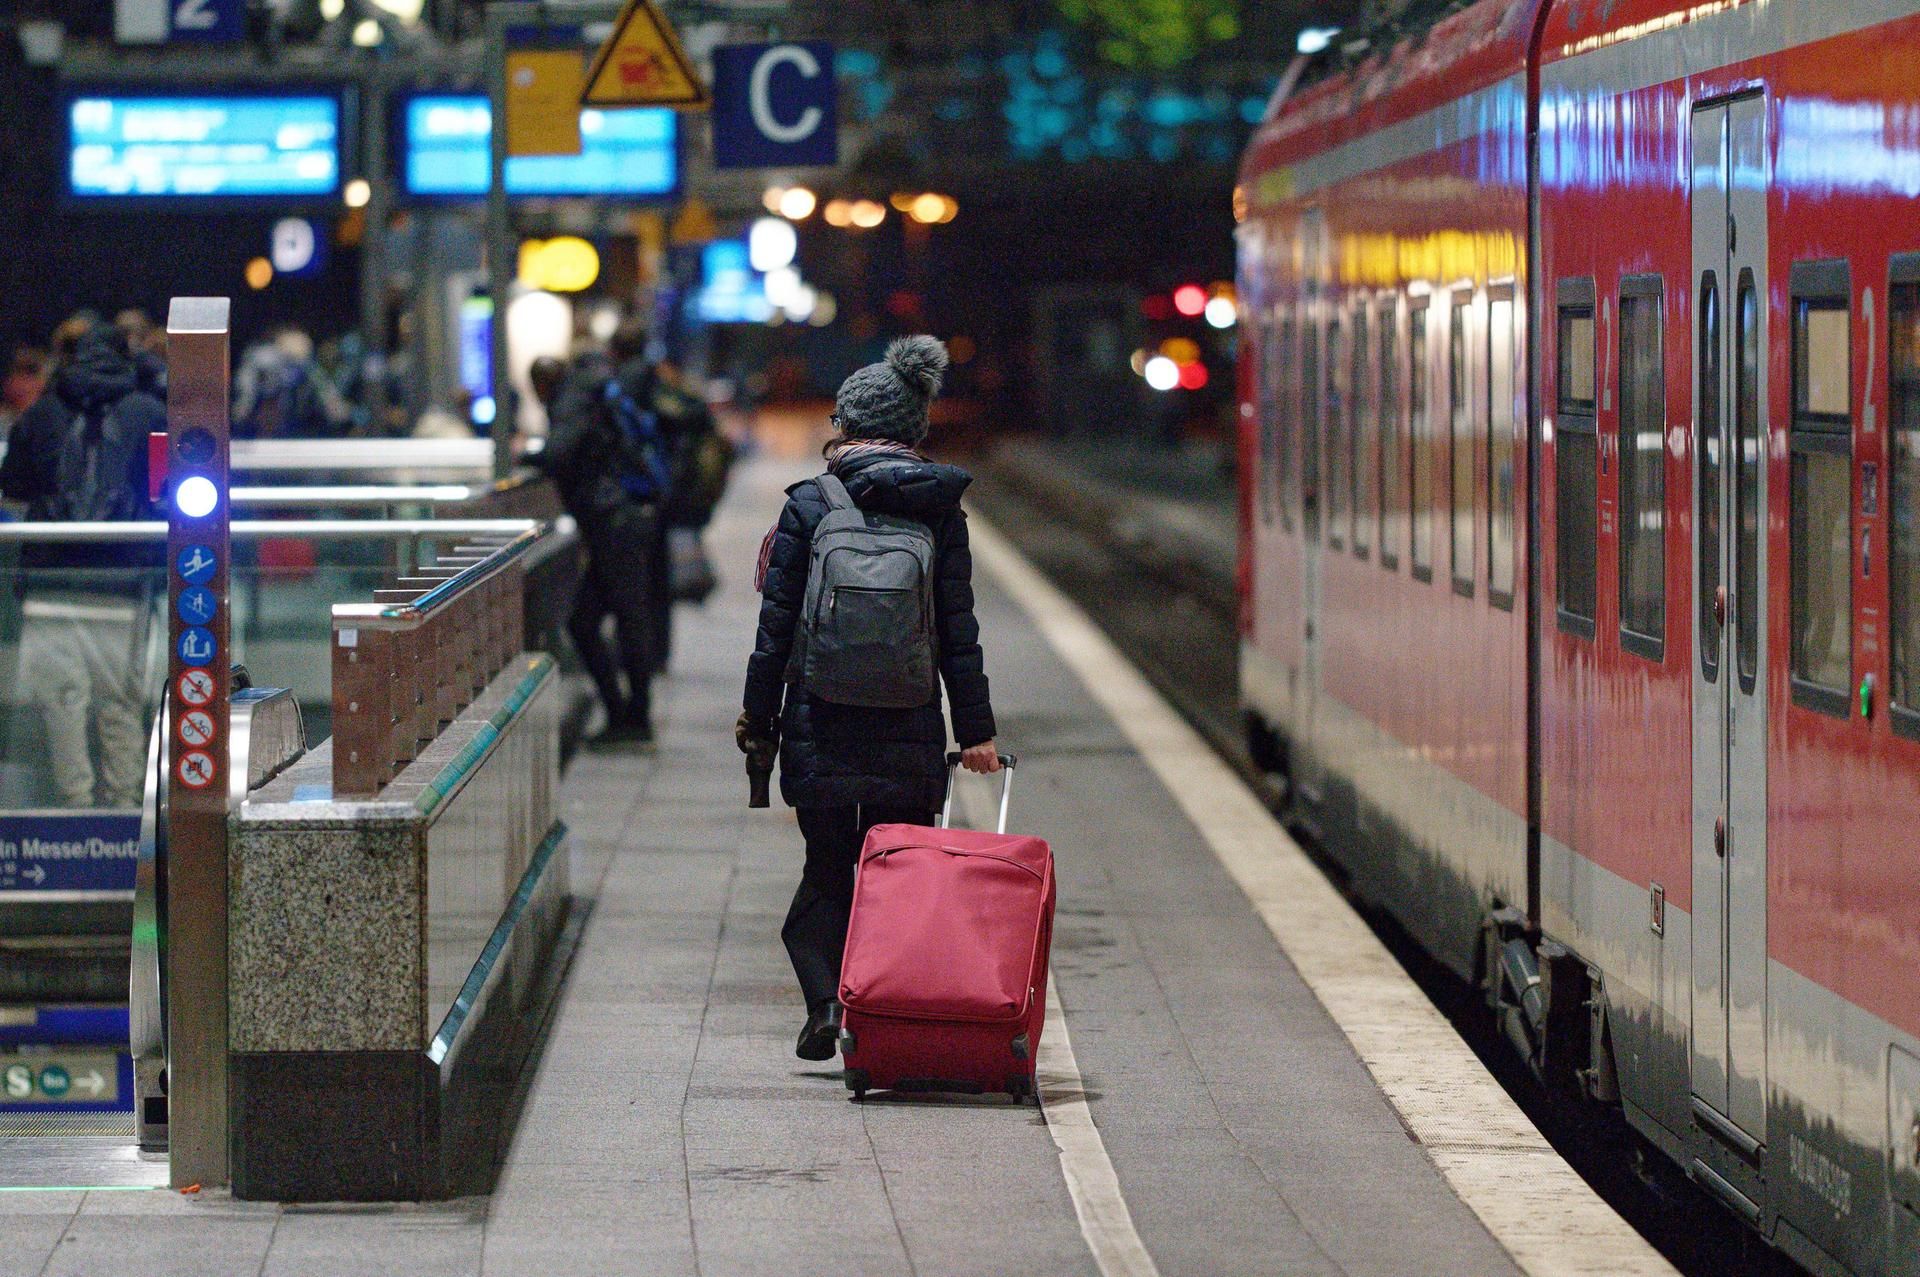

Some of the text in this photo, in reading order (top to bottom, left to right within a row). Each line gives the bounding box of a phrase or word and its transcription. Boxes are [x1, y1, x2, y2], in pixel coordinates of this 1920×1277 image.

[750, 45, 820, 142] C
[1603, 296, 1611, 411] 2
[1861, 287, 1876, 433] 2
[22, 838, 139, 859] Messe/Deut
[6, 1065, 32, 1098] S
